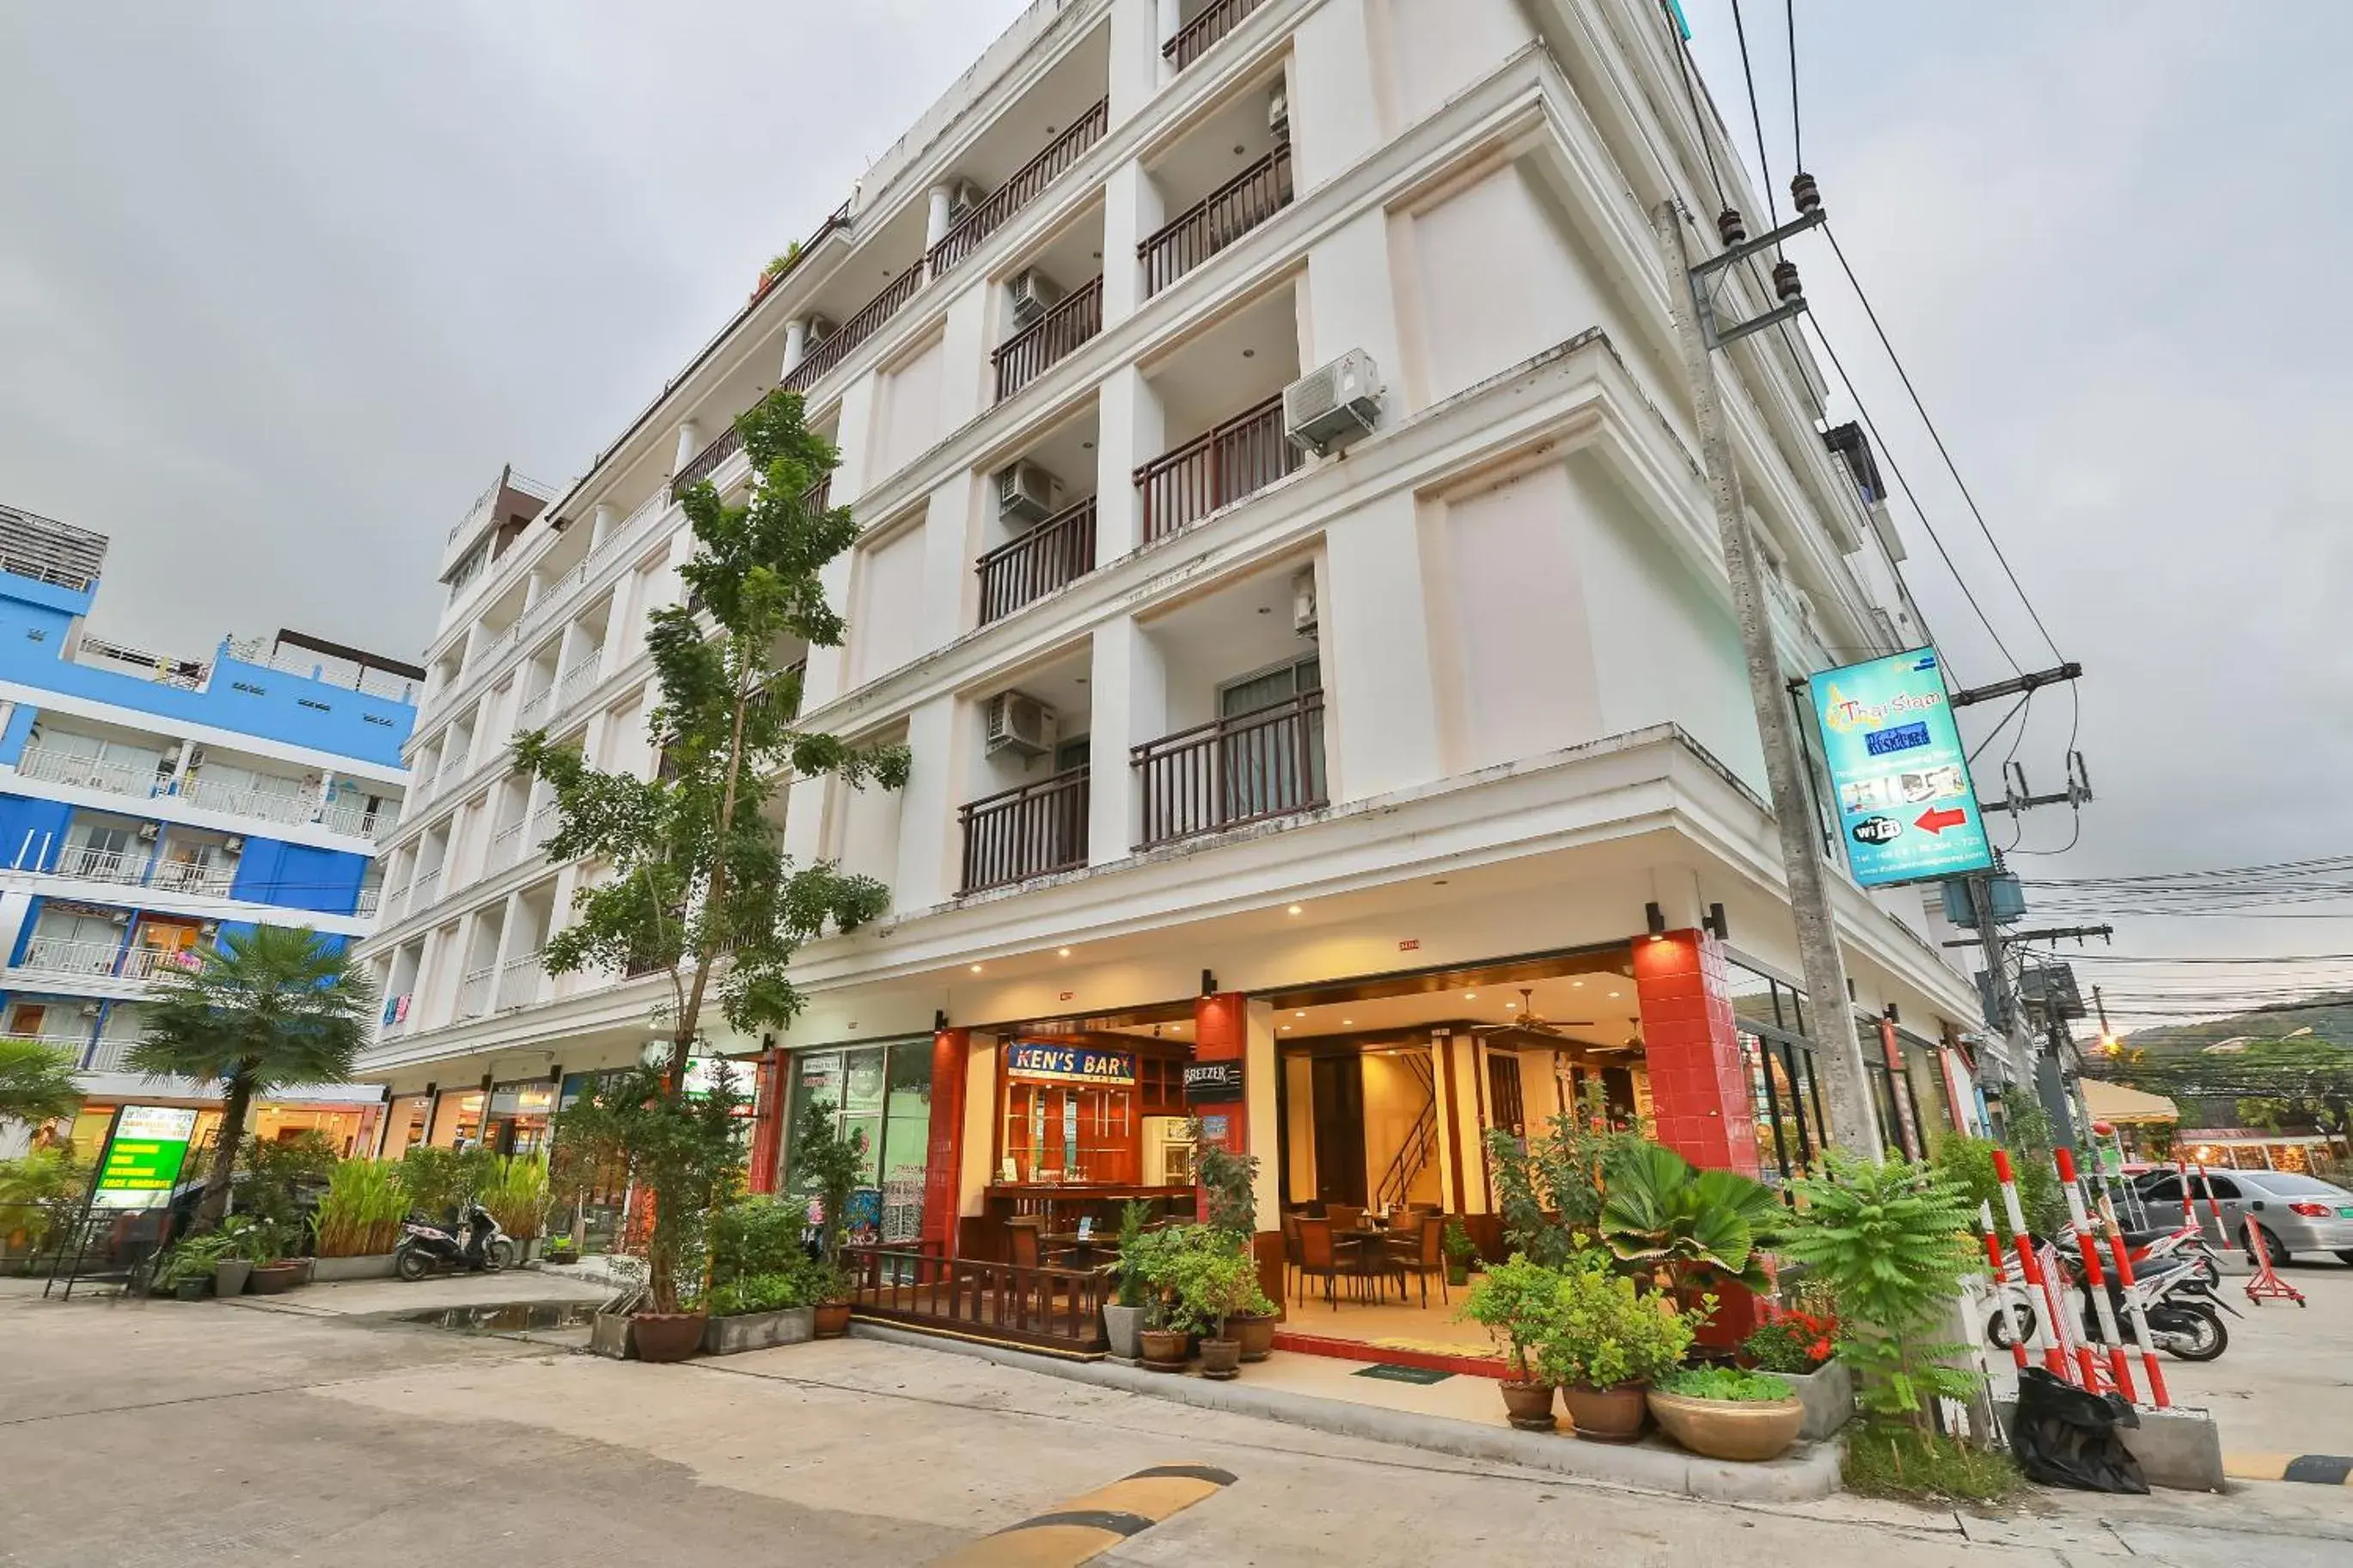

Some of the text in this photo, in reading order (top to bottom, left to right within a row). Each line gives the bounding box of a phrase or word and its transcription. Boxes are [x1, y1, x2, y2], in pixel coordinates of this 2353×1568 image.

[1892, 692, 1942, 711] Siam
[1016, 1050, 1121, 1075] KEN'S BAR
[1183, 1065, 1227, 1084] BREEZER
